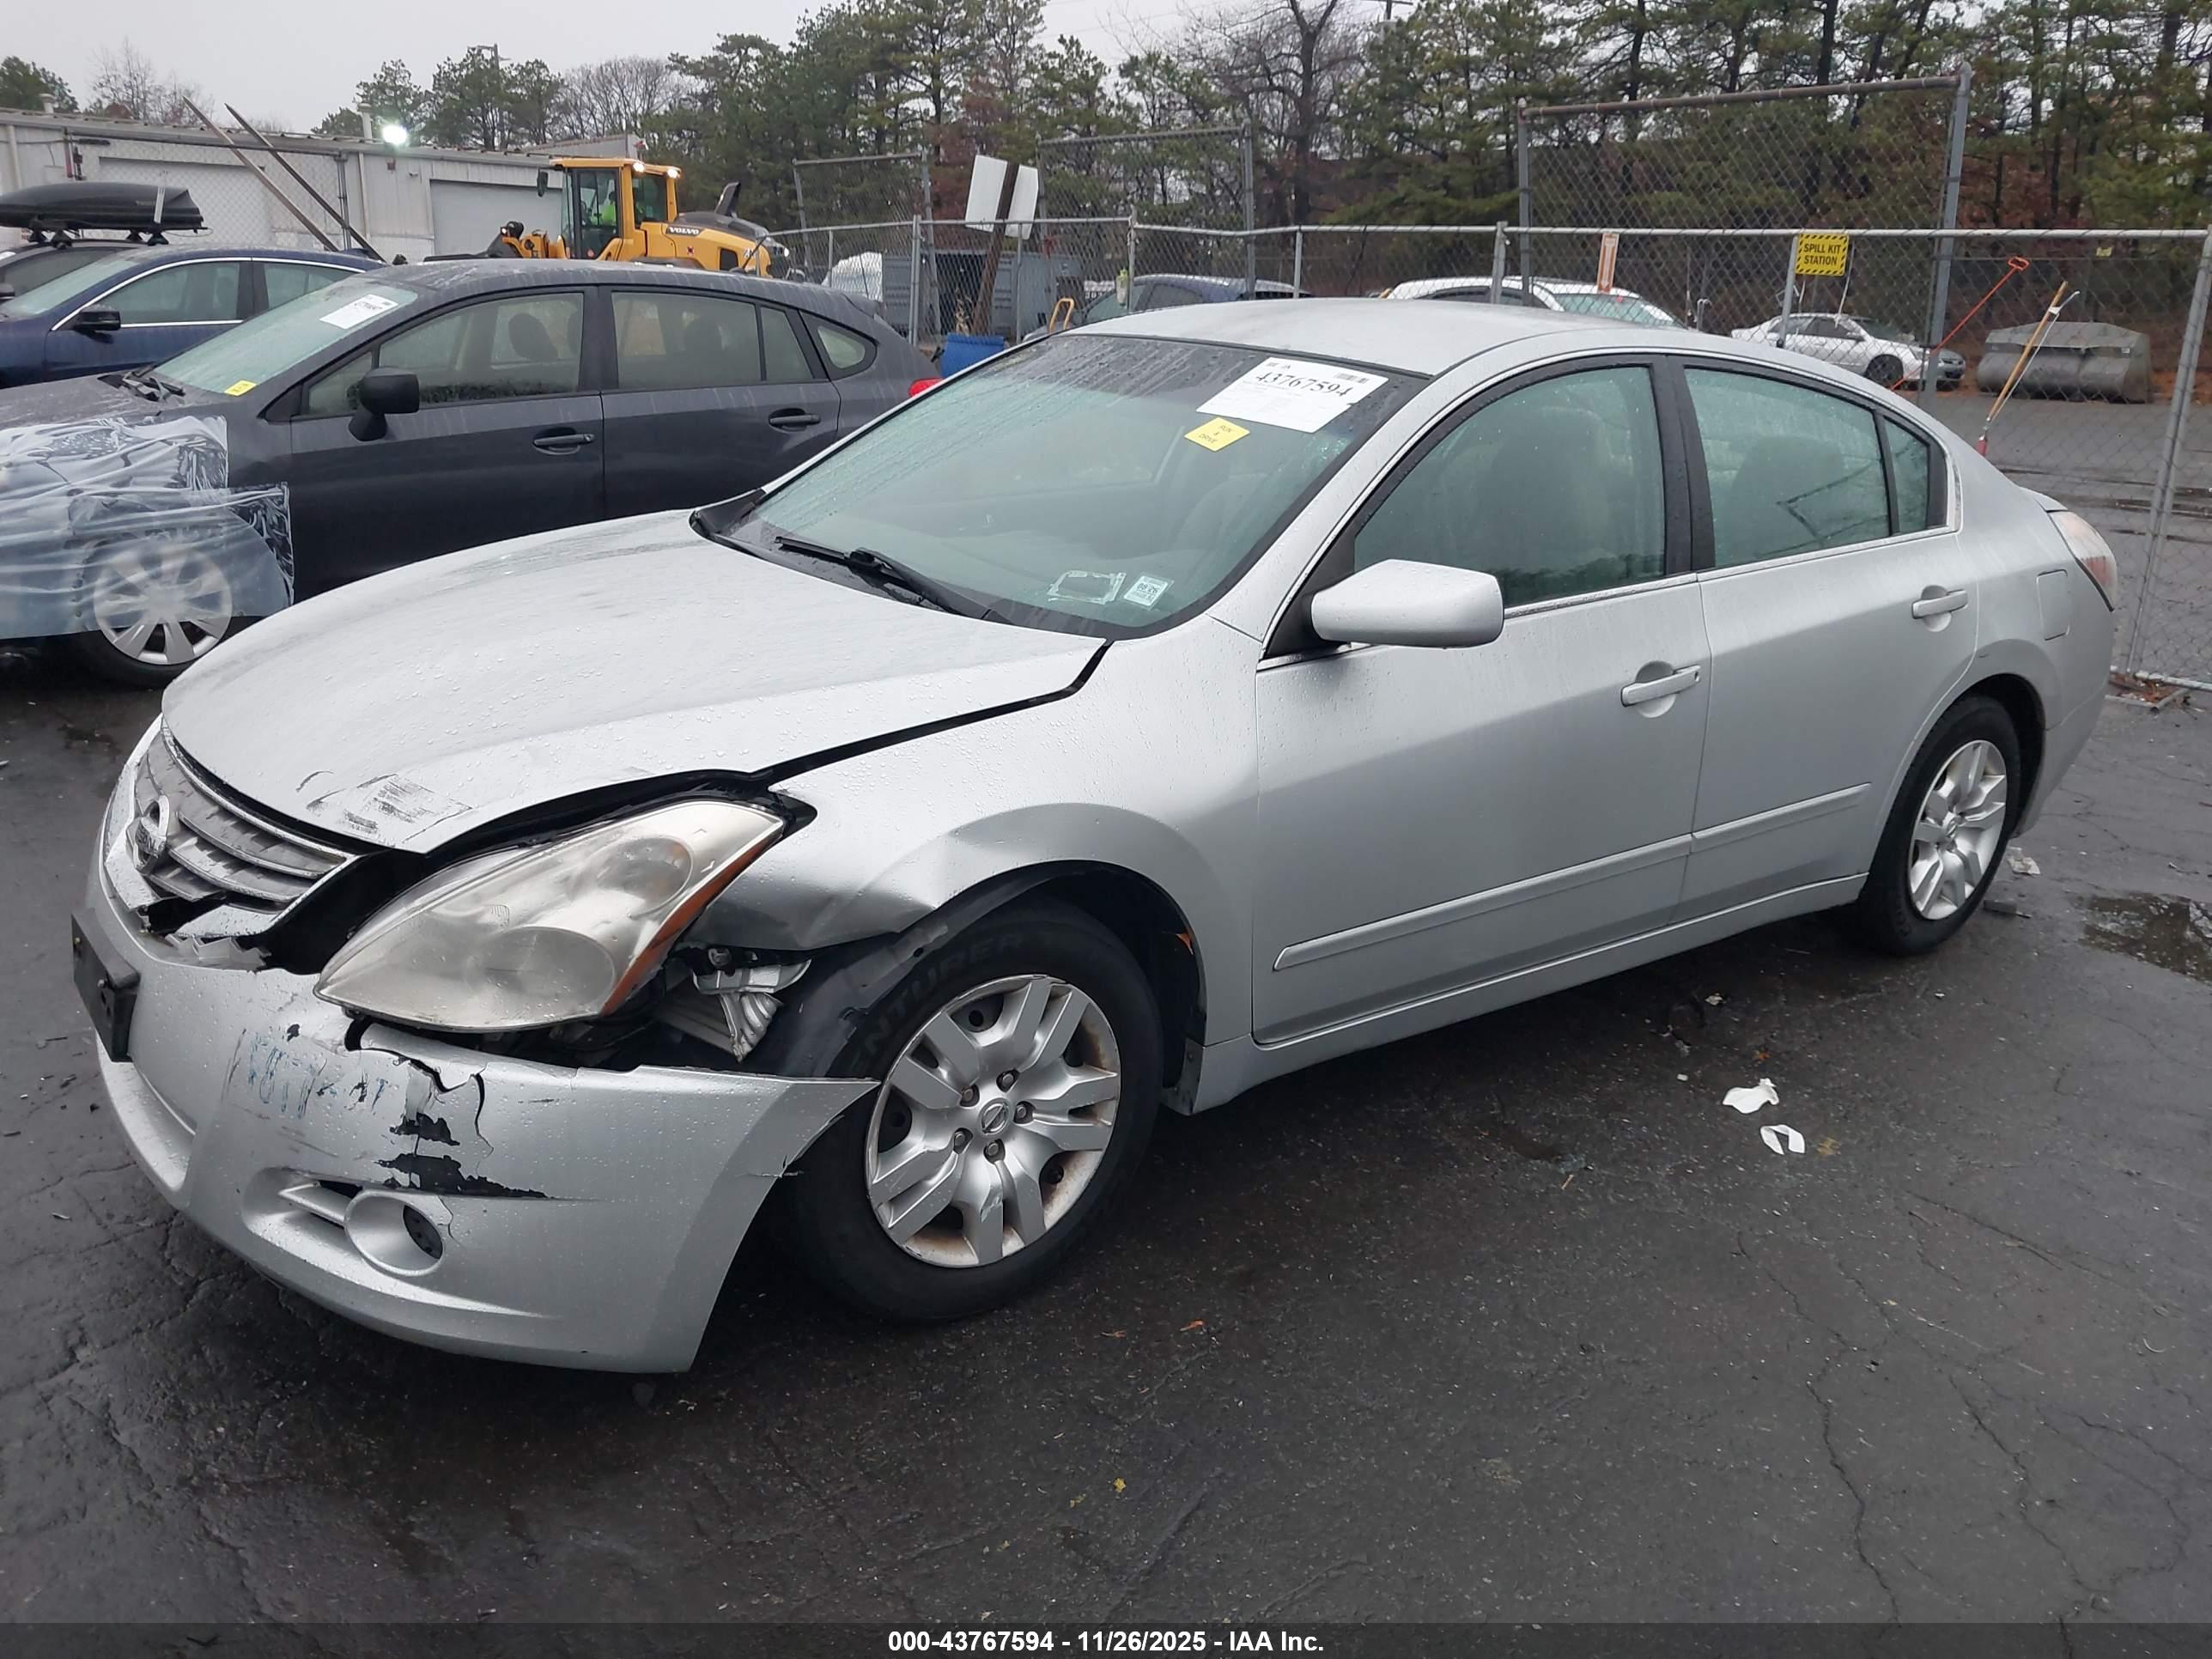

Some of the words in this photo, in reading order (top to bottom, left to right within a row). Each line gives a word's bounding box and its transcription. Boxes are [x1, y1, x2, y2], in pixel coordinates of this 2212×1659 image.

[1803, 243, 1825, 253] SPILL
[1828, 244, 1841, 254] KIT
[1804, 255, 1838, 265] STATION
[1255, 372, 1354, 397] 43767594
